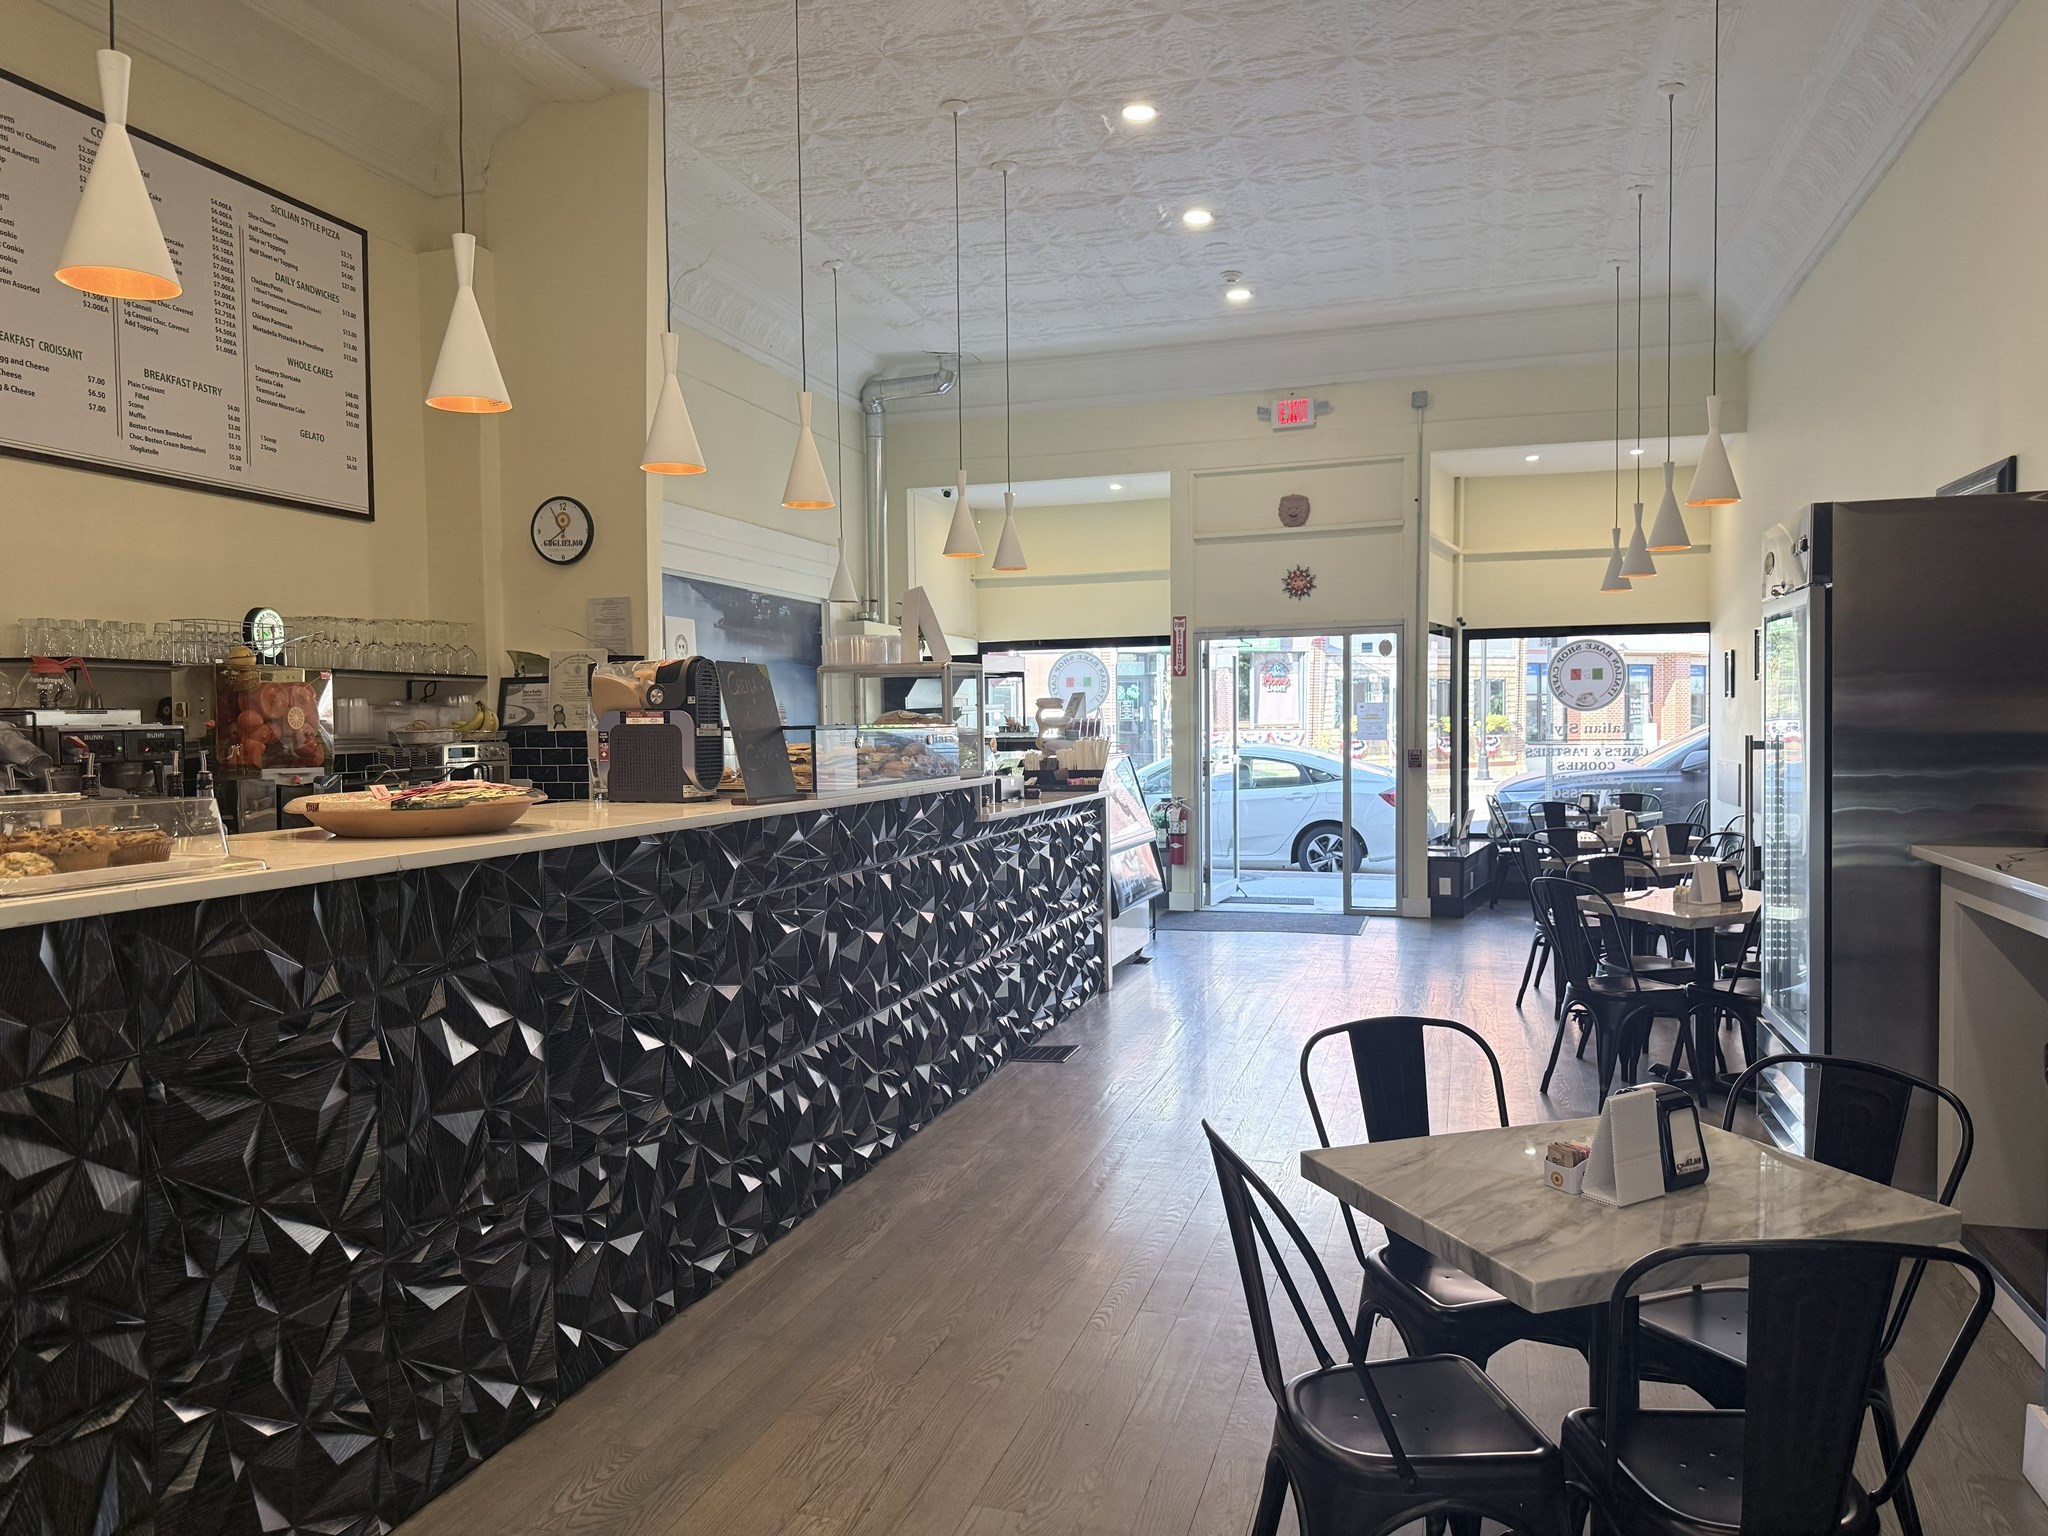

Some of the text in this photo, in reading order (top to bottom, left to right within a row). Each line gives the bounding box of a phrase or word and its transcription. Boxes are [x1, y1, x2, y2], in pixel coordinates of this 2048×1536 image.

[25, 133, 56, 151] Chocolate
[12, 148, 40, 164] Amaretti
[248, 212, 276, 228] Slice Cheese
[270, 204, 340, 240] SICILIAN STYLE PIZZA
[248, 224, 288, 244] Half Sheet Cheese
[2, 242, 24, 254] Cookie
[248, 234, 260, 244] Slice
[267, 242, 286, 256] Topping
[249, 246, 260, 256] Half
[260, 250, 273, 260] Sheet
[280, 258, 299, 272] Topping
[12, 280, 40, 294] Assorted
[275, 272, 340, 304] DAILY SANDWICHES
[83, 300, 110, 314] $2.00EA
[132, 302, 152, 312] Cannoli
[252, 298, 260, 306] Hot
[172, 304, 194, 316] Covered
[124, 308, 190, 334] Lg Cannoli Choc. Covered
[124, 318, 159, 336] Add Topping
[252, 312, 293, 330] Chicken Parmesan
[252, 324, 278, 338] Mortadella
[278, 332, 298, 344] Pistachio
[302, 340, 324, 352] Provolone
[38, 340, 84, 360] CROISSANT
[10, 358, 50, 372] and Cheese
[287, 357, 334, 378] WHOLE CAKES
[88, 375, 106, 386] $7.00
[254, 364, 301, 384] Strawberry Shortcake
[128, 380, 166, 395] Plain Croissant
[144, 368, 222, 396] BREAKFAST PASTRY
[272, 380, 284, 388] Cake
[10, 385, 36, 397] Cheese
[88, 388, 106, 399] $6.50
[134, 392, 150, 401] Filled
[276, 391, 286, 400] Cake
[88, 402, 106, 413] $7.00
[128, 400, 144, 410] Scone
[256, 396, 306, 414] Chocolate Mousse Cake
[1278, 399, 1308, 424] EXIT
[128, 410, 146, 420] Muffin
[129, 422, 192, 440] Boston Cream Bomboloni
[300, 429, 325, 442] GELATO
[130, 432, 206, 454] Choc. Boston Cream Bomboloni
[130, 444, 160, 456] Sfogliatelle
[560, 502, 566, 510] 12
